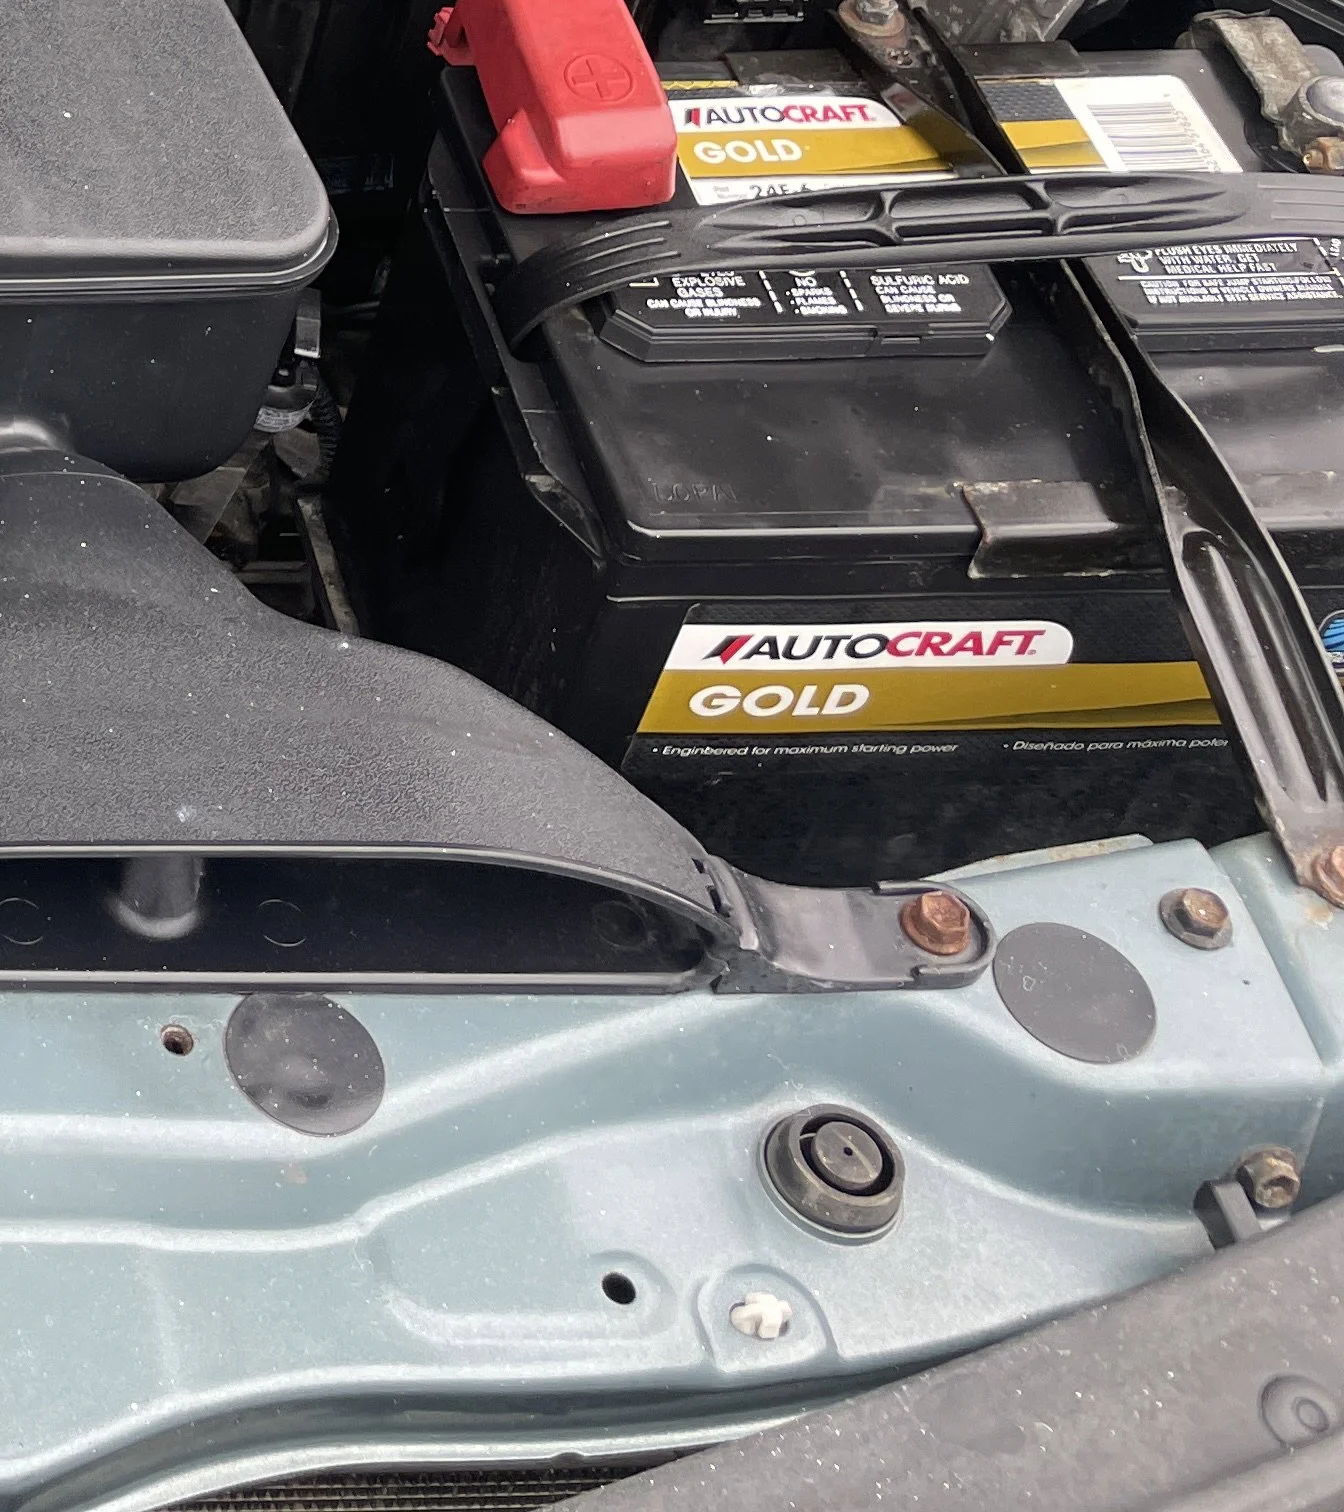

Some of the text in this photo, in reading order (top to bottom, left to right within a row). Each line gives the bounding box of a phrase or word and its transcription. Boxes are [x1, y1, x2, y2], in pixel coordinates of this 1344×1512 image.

[706, 103, 869, 125] AUTOCRAFT
[693, 138, 803, 165] GOLD
[1192, 244, 1223, 254] EYES
[1223, 242, 1298, 254] IMMEDIATELY
[1158, 254, 1190, 265] WITH
[1238, 252, 1260, 263] GET
[1163, 262, 1278, 275] MEDICAL HELP FAST
[672, 276, 746, 287] EXPLOSIVE
[794, 276, 817, 287] NO
[870, 273, 970, 285] SULFURIC ACID
[677, 287, 724, 298] GASES
[745, 629, 1048, 660] AUTOCRAFT
[689, 684, 871, 717] GOLD
[751, 745, 771, 756] for
[774, 744, 848, 755] maximum
[851, 742, 907, 756] starting
[910, 743, 959, 754] power
[1012, 739, 1085, 751] Diseñado
[1087, 741, 1123, 751] para
[1127, 738, 1186, 749] máxima
